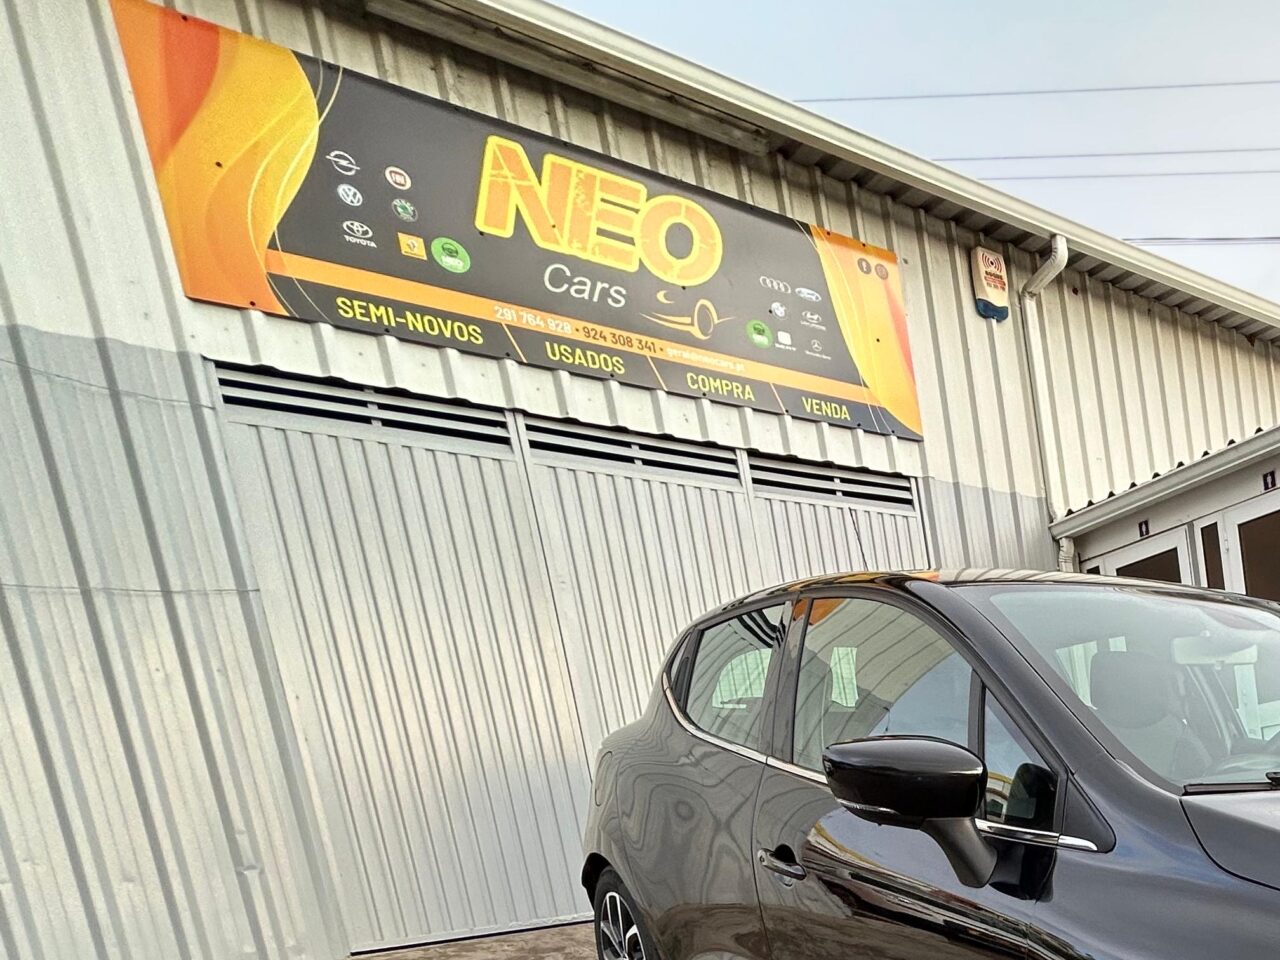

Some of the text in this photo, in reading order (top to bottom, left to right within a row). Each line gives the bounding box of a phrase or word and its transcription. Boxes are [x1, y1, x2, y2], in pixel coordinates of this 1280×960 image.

[475, 135, 723, 286] NEO
[343, 235, 378, 249] TOYOTA
[543, 263, 627, 308] Cars
[335, 297, 484, 345] SEMI-NOVOS
[494, 305, 517, 322] 291
[519, 311, 545, 328] 764
[547, 318, 572, 334] 928
[582, 327, 607, 342] 924
[611, 333, 633, 348] 308
[637, 338, 657, 353] 341
[545, 341, 626, 375] USADOS
[686, 372, 756, 402] COMPRA
[801, 396, 851, 421] VENDA
